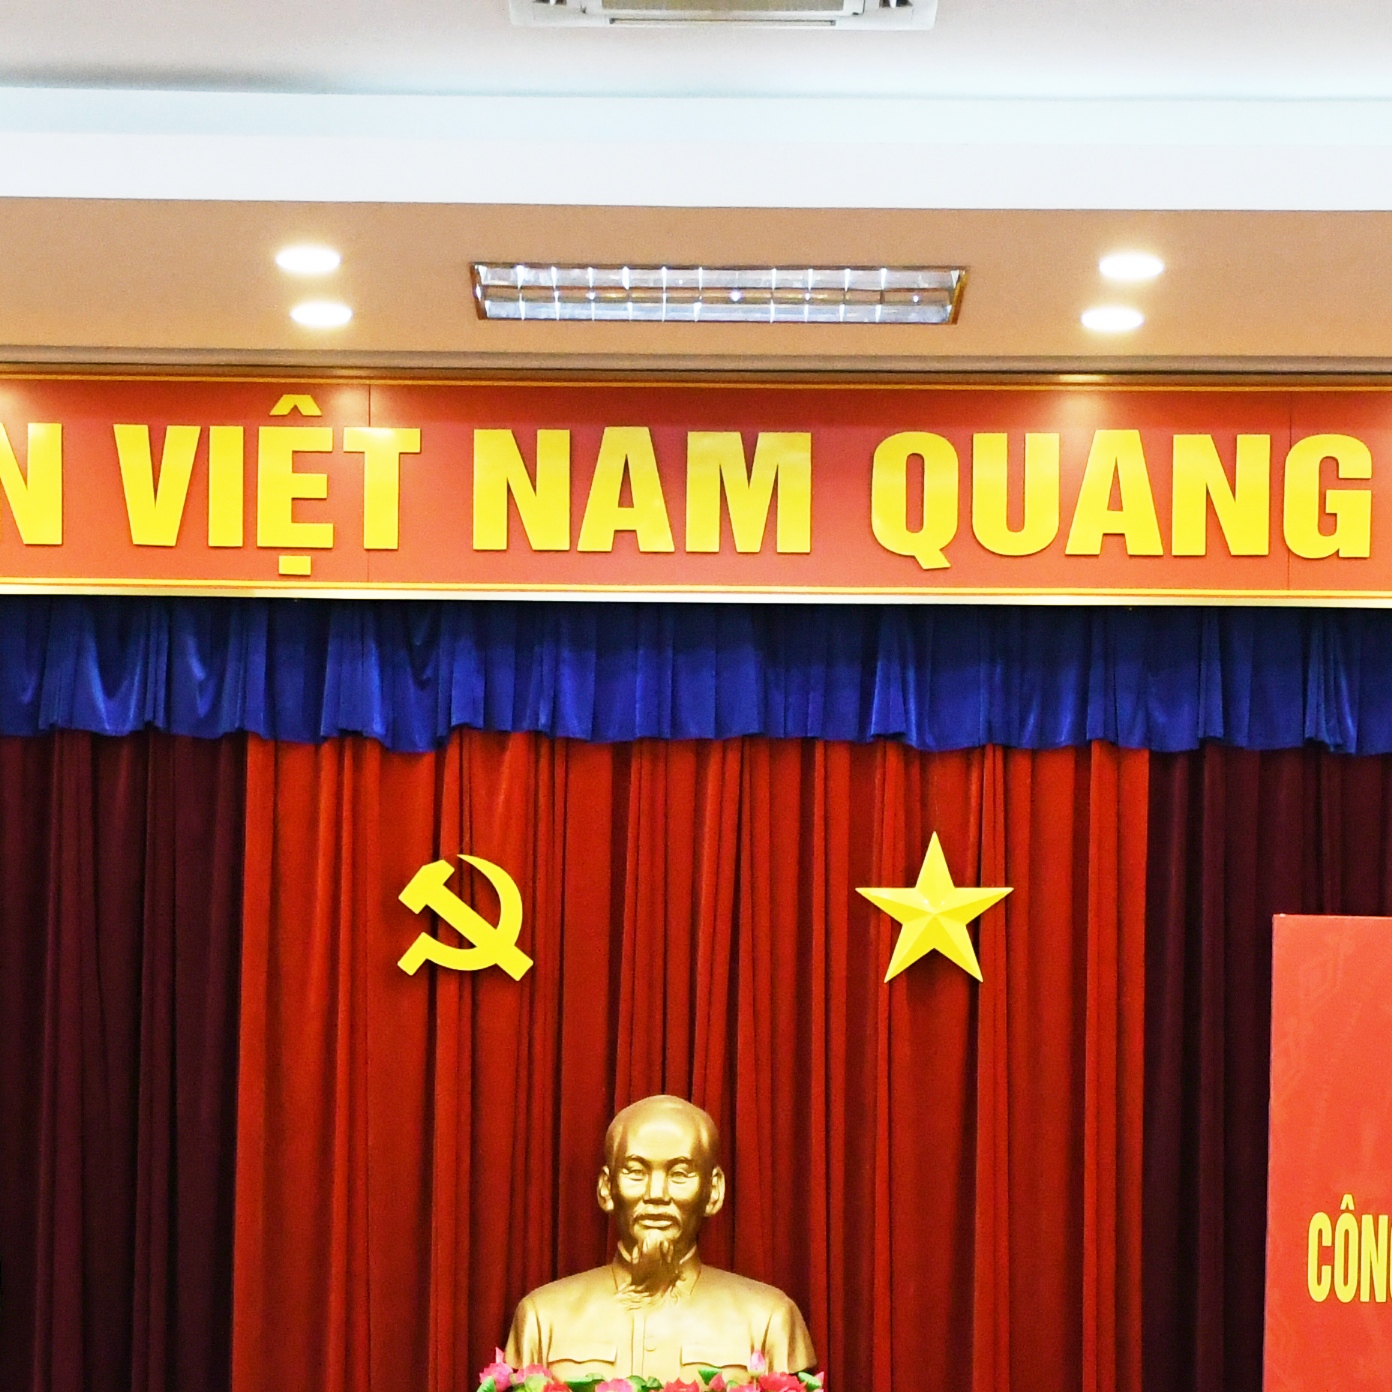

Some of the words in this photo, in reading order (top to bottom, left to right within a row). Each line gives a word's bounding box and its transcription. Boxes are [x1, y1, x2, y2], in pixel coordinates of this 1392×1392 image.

[113, 395, 421, 576] VIỆT
[472, 426, 812, 554] NAM
[870, 428, 1373, 570] QUANG
